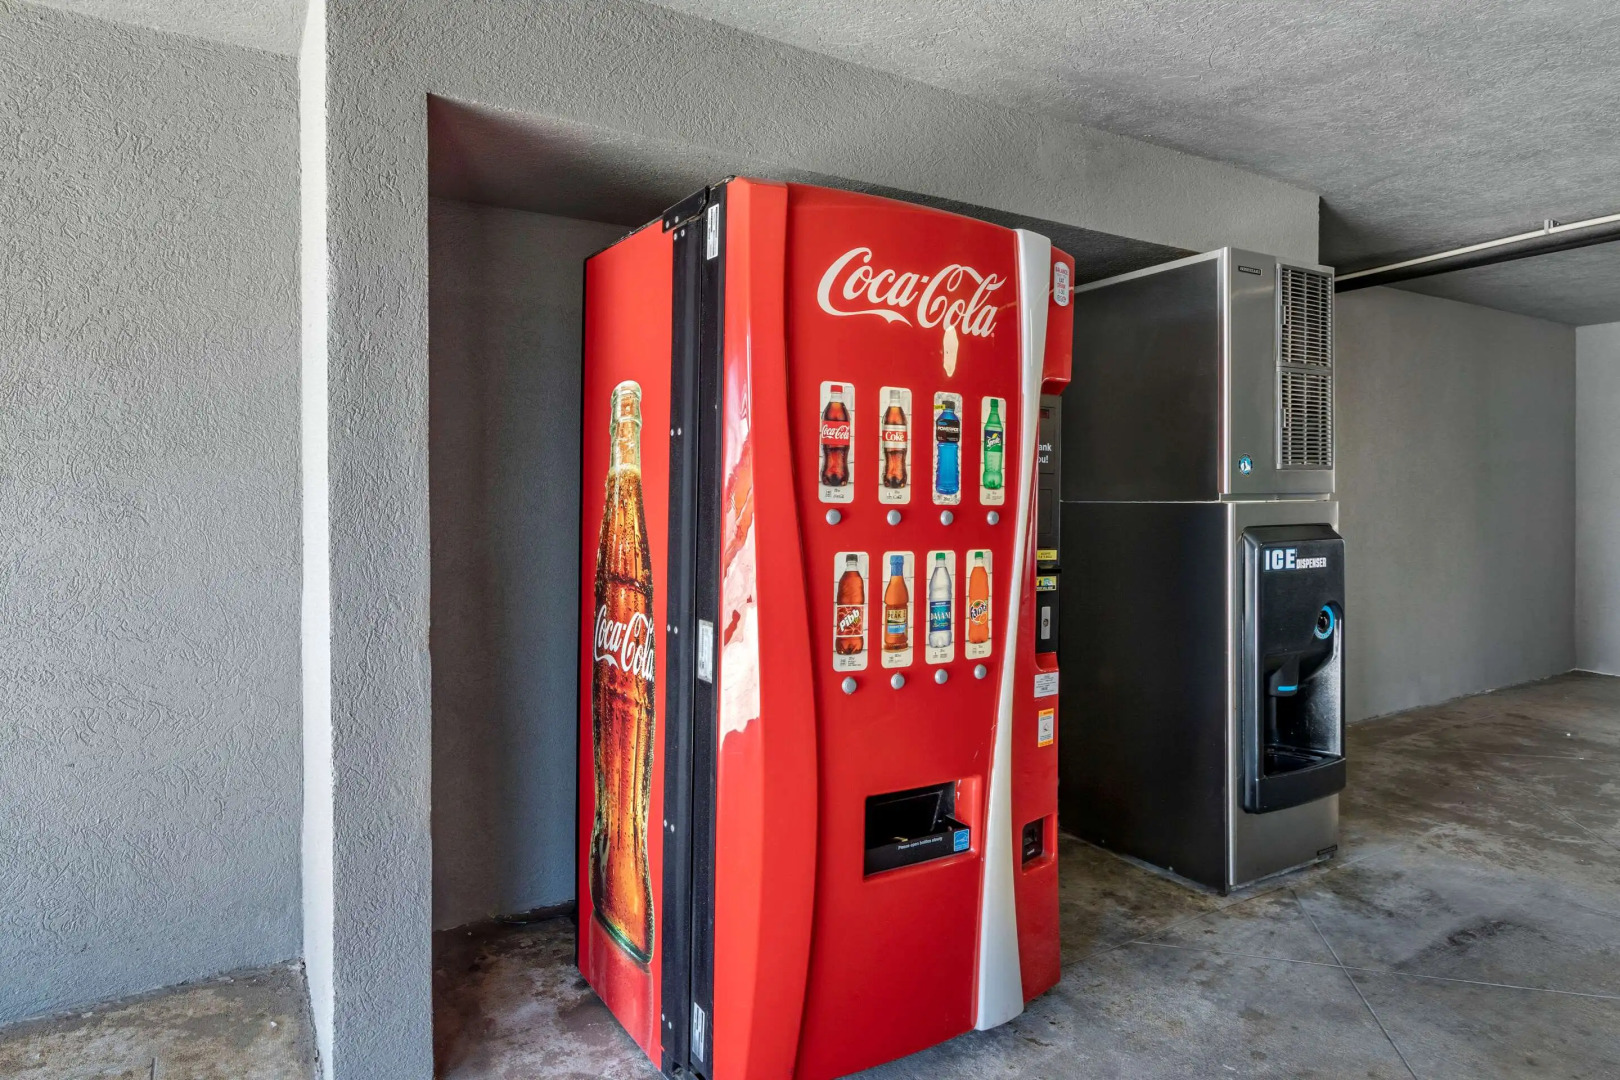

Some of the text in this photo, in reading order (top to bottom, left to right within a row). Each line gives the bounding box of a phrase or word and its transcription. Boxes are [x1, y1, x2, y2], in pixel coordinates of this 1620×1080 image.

[816, 247, 1007, 338] Coca-Cola
[821, 424, 850, 440] Coca-Cola
[885, 431, 905, 442] Coke
[1038, 443, 1052, 452] ank
[1265, 549, 1327, 571] ICE DISPENSER
[839, 609, 860, 633] Pibb
[970, 603, 987, 620] Fanta
[594, 604, 655, 682] Coca-Cola
